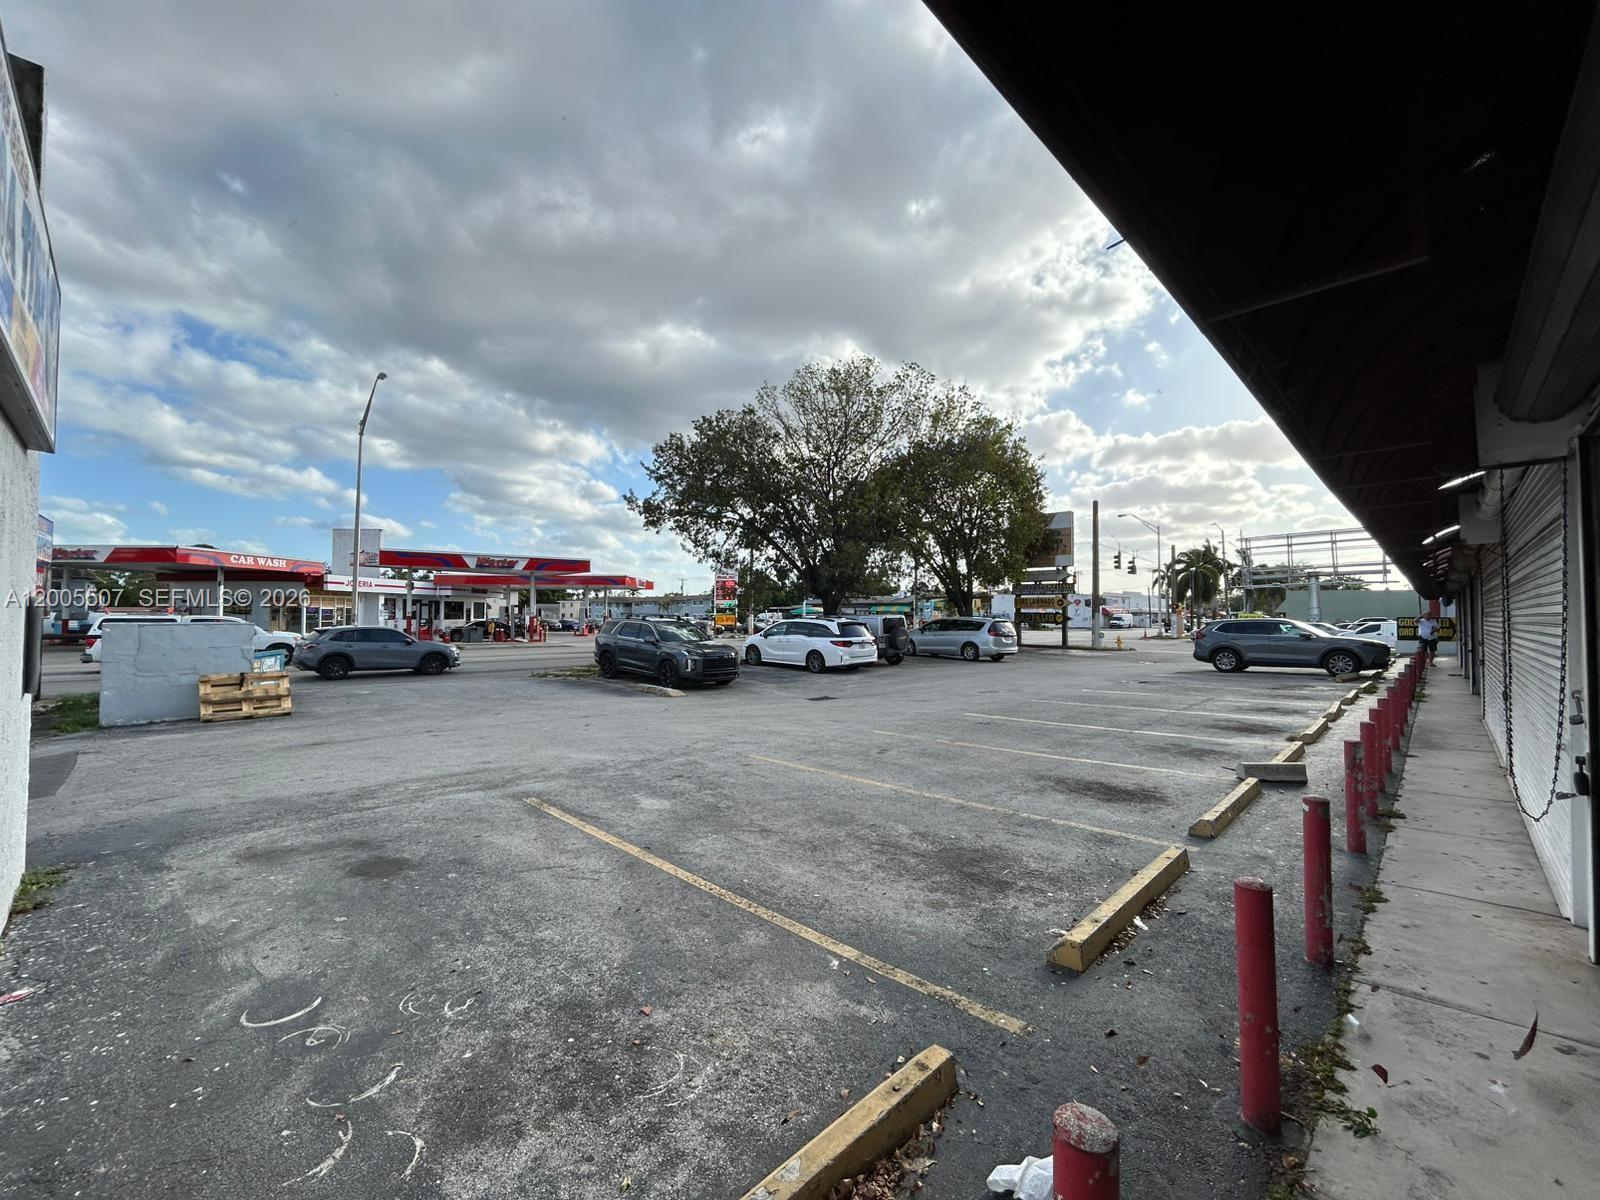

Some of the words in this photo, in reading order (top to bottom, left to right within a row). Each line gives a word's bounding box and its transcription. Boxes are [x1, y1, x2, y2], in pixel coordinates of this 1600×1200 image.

[230, 554, 255, 566] CAR
[257, 557, 287, 568] WASH
[345, 579, 374, 589] JOERIA
[1399, 628, 1414, 636] ORO
